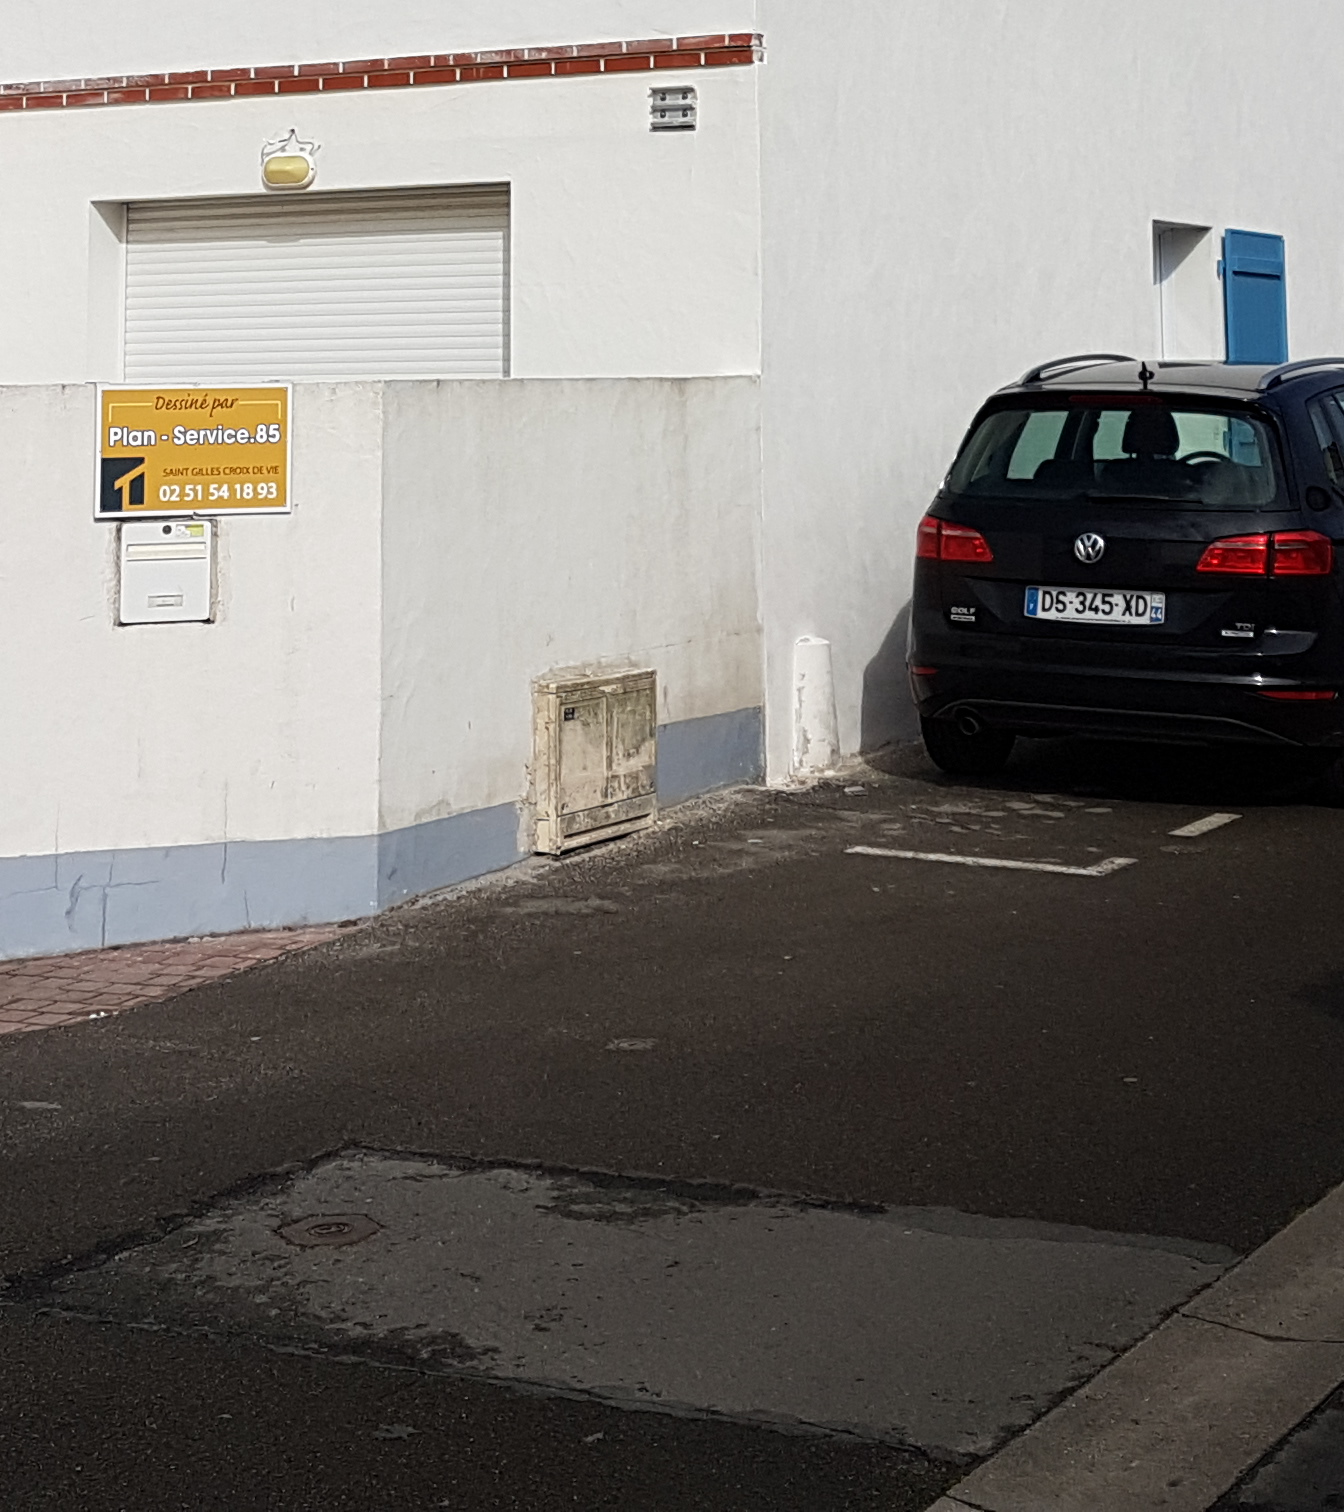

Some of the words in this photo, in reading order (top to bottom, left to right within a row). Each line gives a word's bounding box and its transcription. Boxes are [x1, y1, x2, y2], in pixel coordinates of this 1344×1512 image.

[154, 393, 209, 411] Dessiné
[208, 397, 238, 418] par
[108, 426, 157, 447] Plan
[173, 423, 281, 446] Service.85
[163, 467, 189, 477] SAINT
[191, 467, 221, 477] GILLES
[223, 466, 251, 476] CROIX
[252, 466, 264, 475] DE
[266, 466, 280, 475] VIE
[159, 485, 180, 501] 02
[184, 485, 203, 501] 51
[208, 484, 230, 500] 54
[234, 483, 254, 499] 18
[257, 482, 277, 499] 93
[1041, 590, 1148, 618] DS-345-XD
[1150, 608, 1163, 620] 44
